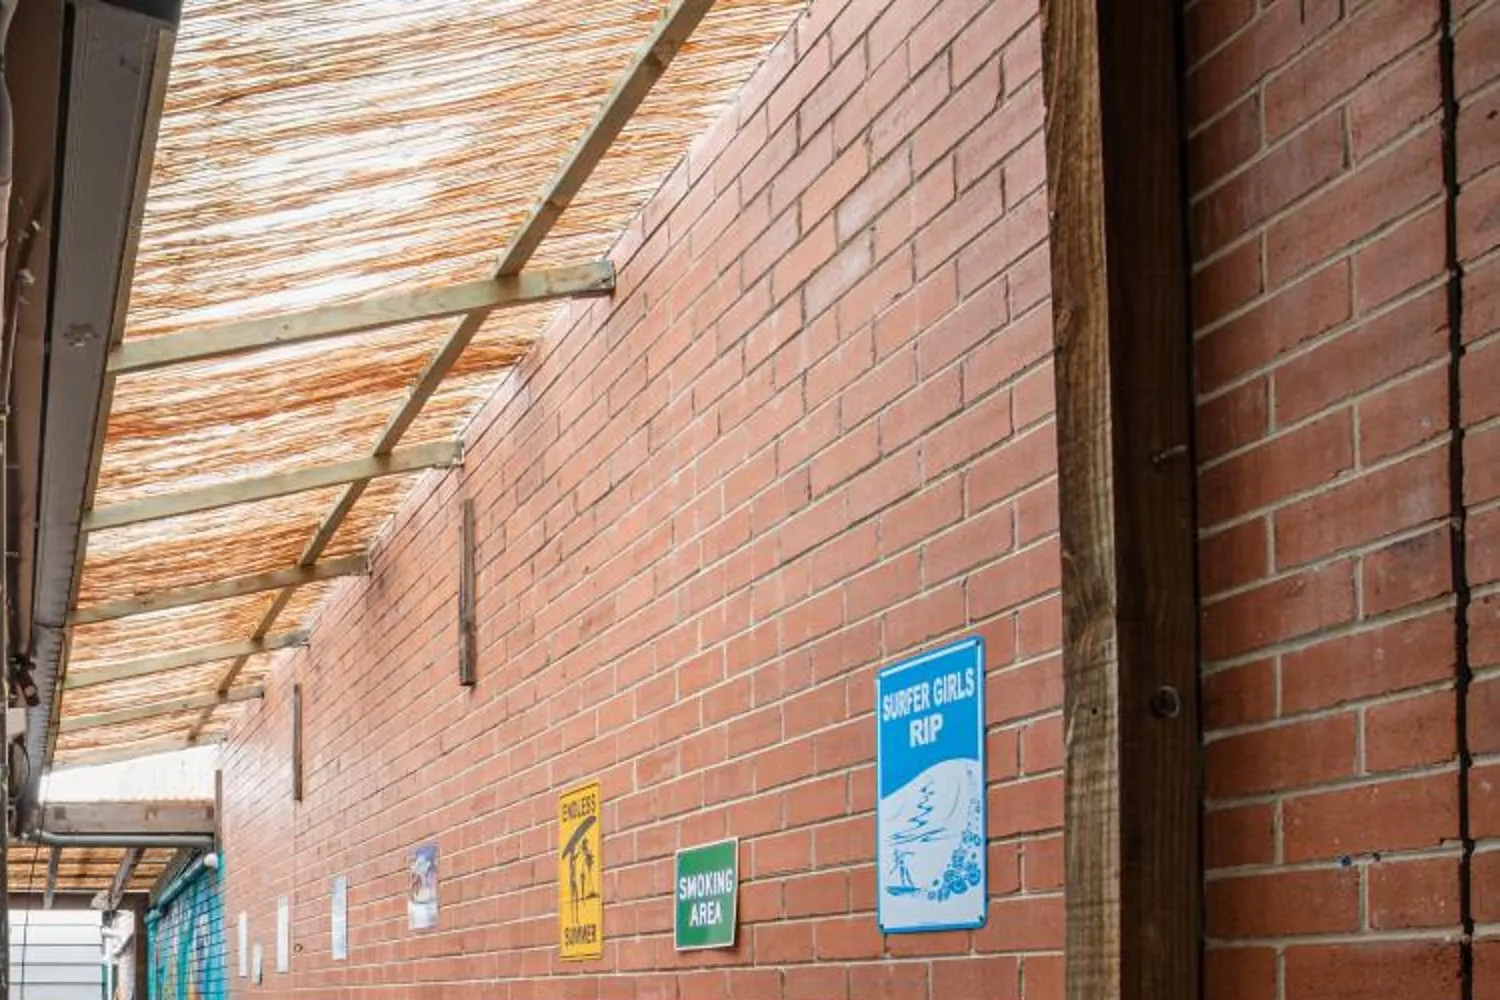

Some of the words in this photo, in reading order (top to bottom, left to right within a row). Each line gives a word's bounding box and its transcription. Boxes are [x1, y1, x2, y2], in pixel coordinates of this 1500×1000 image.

[883, 682, 930, 721] SURFER
[934, 667, 975, 707] GIRLS
[909, 713, 944, 748] RIP
[679, 869, 733, 900] SMOKING
[689, 902, 722, 927] AREA
